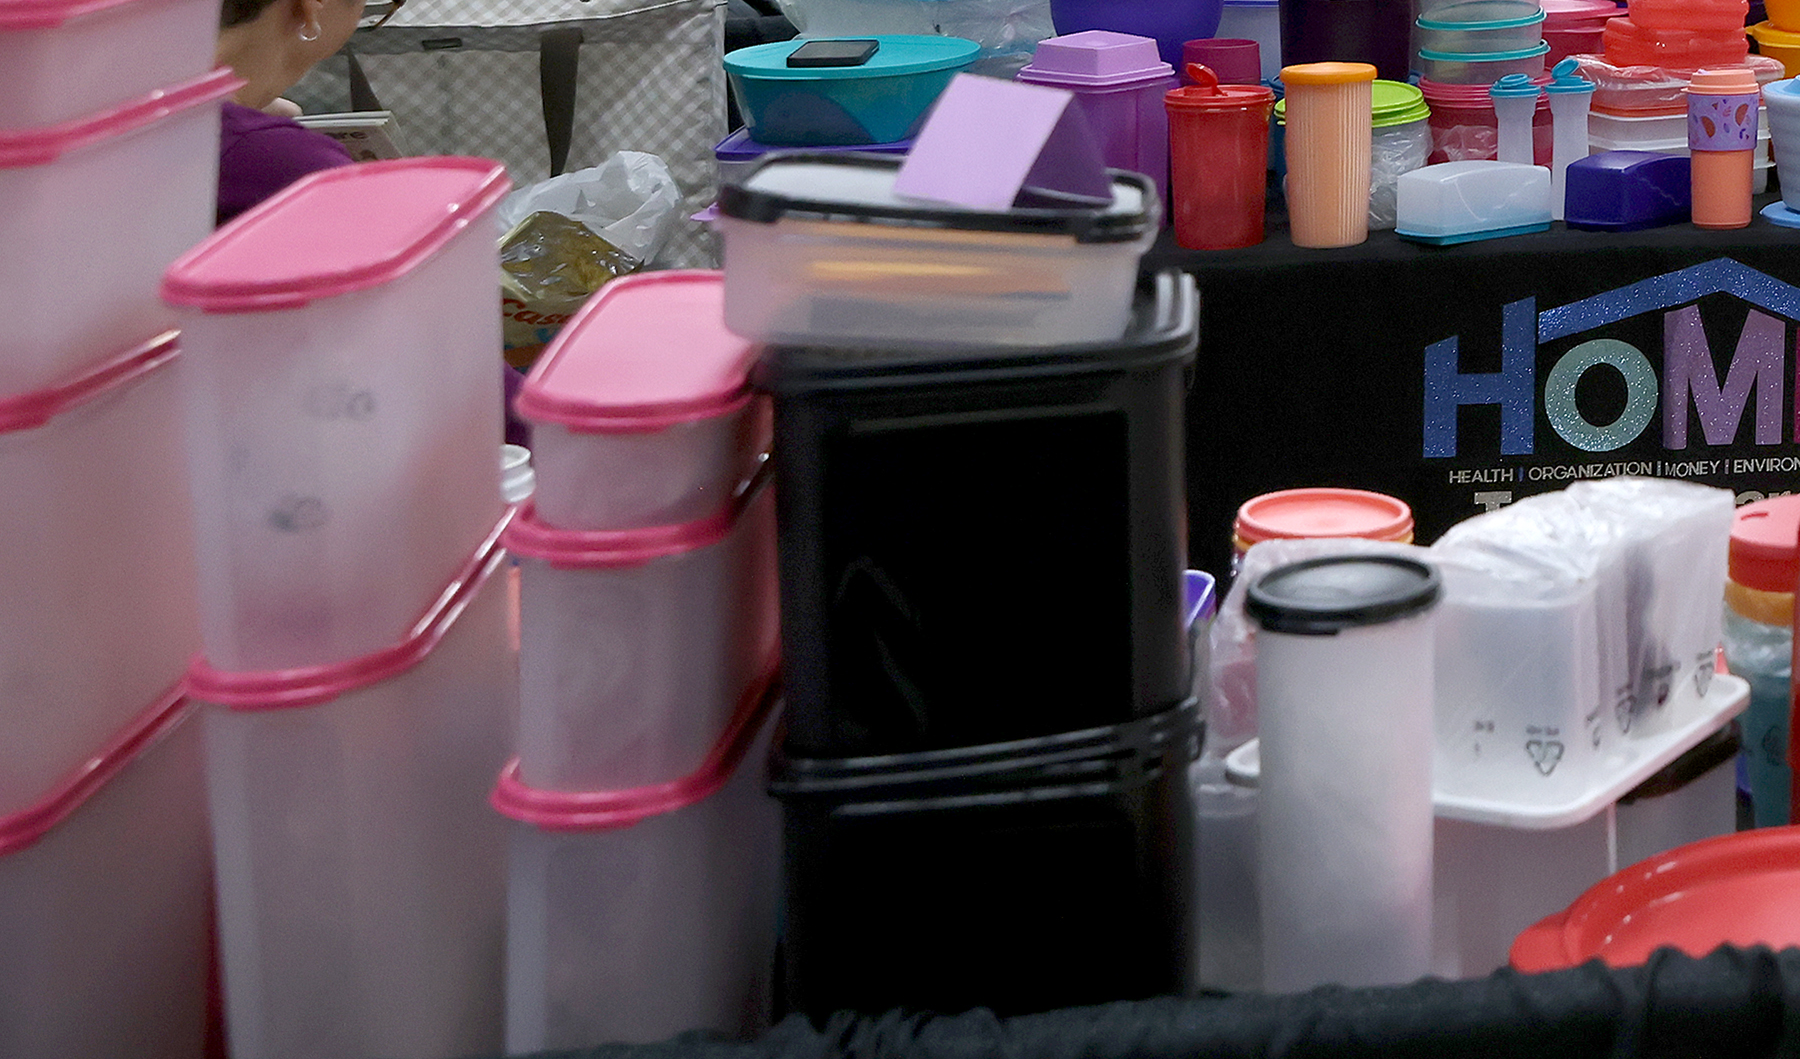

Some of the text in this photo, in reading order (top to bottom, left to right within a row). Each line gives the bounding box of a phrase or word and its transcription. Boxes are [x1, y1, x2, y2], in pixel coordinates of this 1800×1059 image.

[1449, 467, 1514, 485] HEALTH
[1528, 460, 1653, 480] ORGANIZATION
[1664, 458, 1720, 478] MONEY
